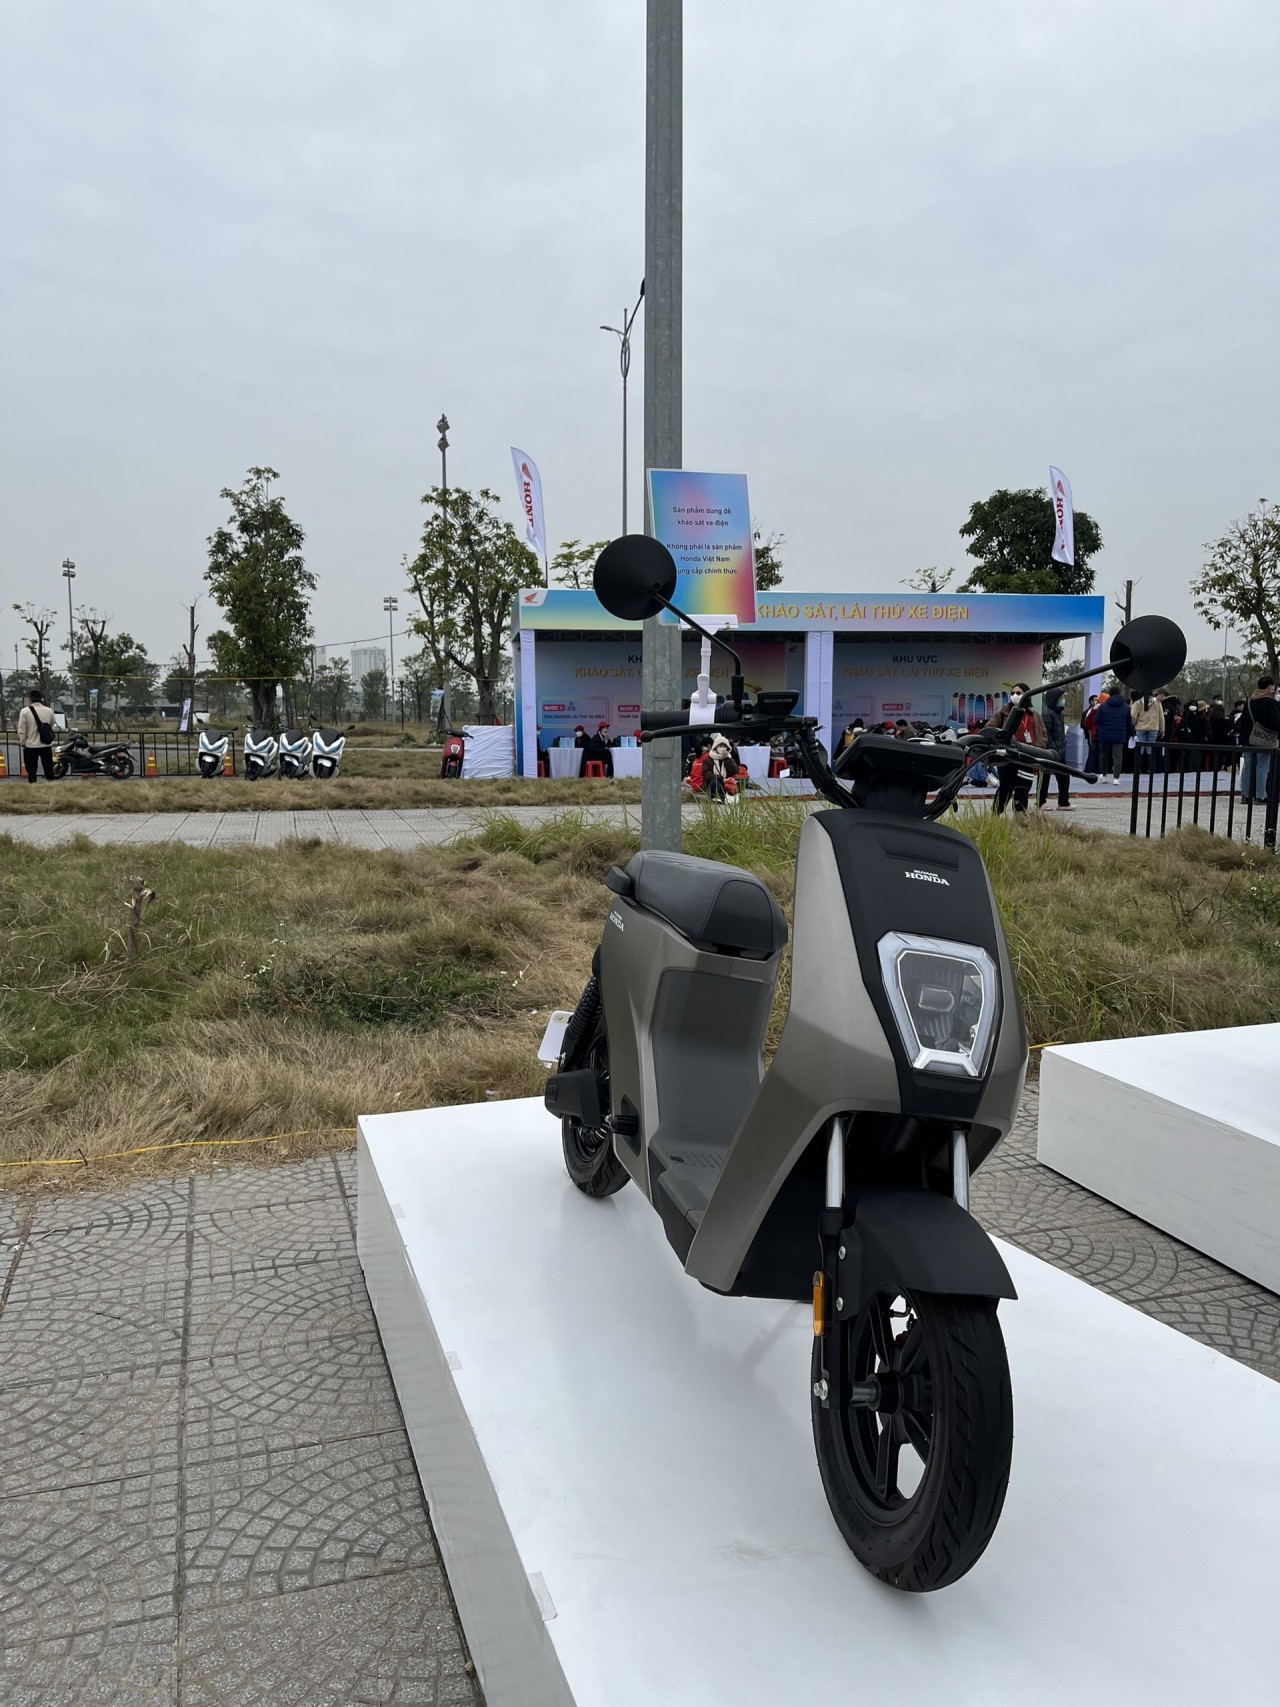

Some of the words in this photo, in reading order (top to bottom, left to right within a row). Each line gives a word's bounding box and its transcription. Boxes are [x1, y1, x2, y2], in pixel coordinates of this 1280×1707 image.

[758, 602, 800, 619] KHẢO
[804, 602, 838, 621] SÁT,
[841, 602, 866, 619] LÁI
[908, 605, 929, 619] XE
[932, 603, 969, 622] ĐIỆN
[892, 654, 914, 664] KHU
[916, 654, 938, 665] VỰC
[904, 872, 950, 886] HONDA
